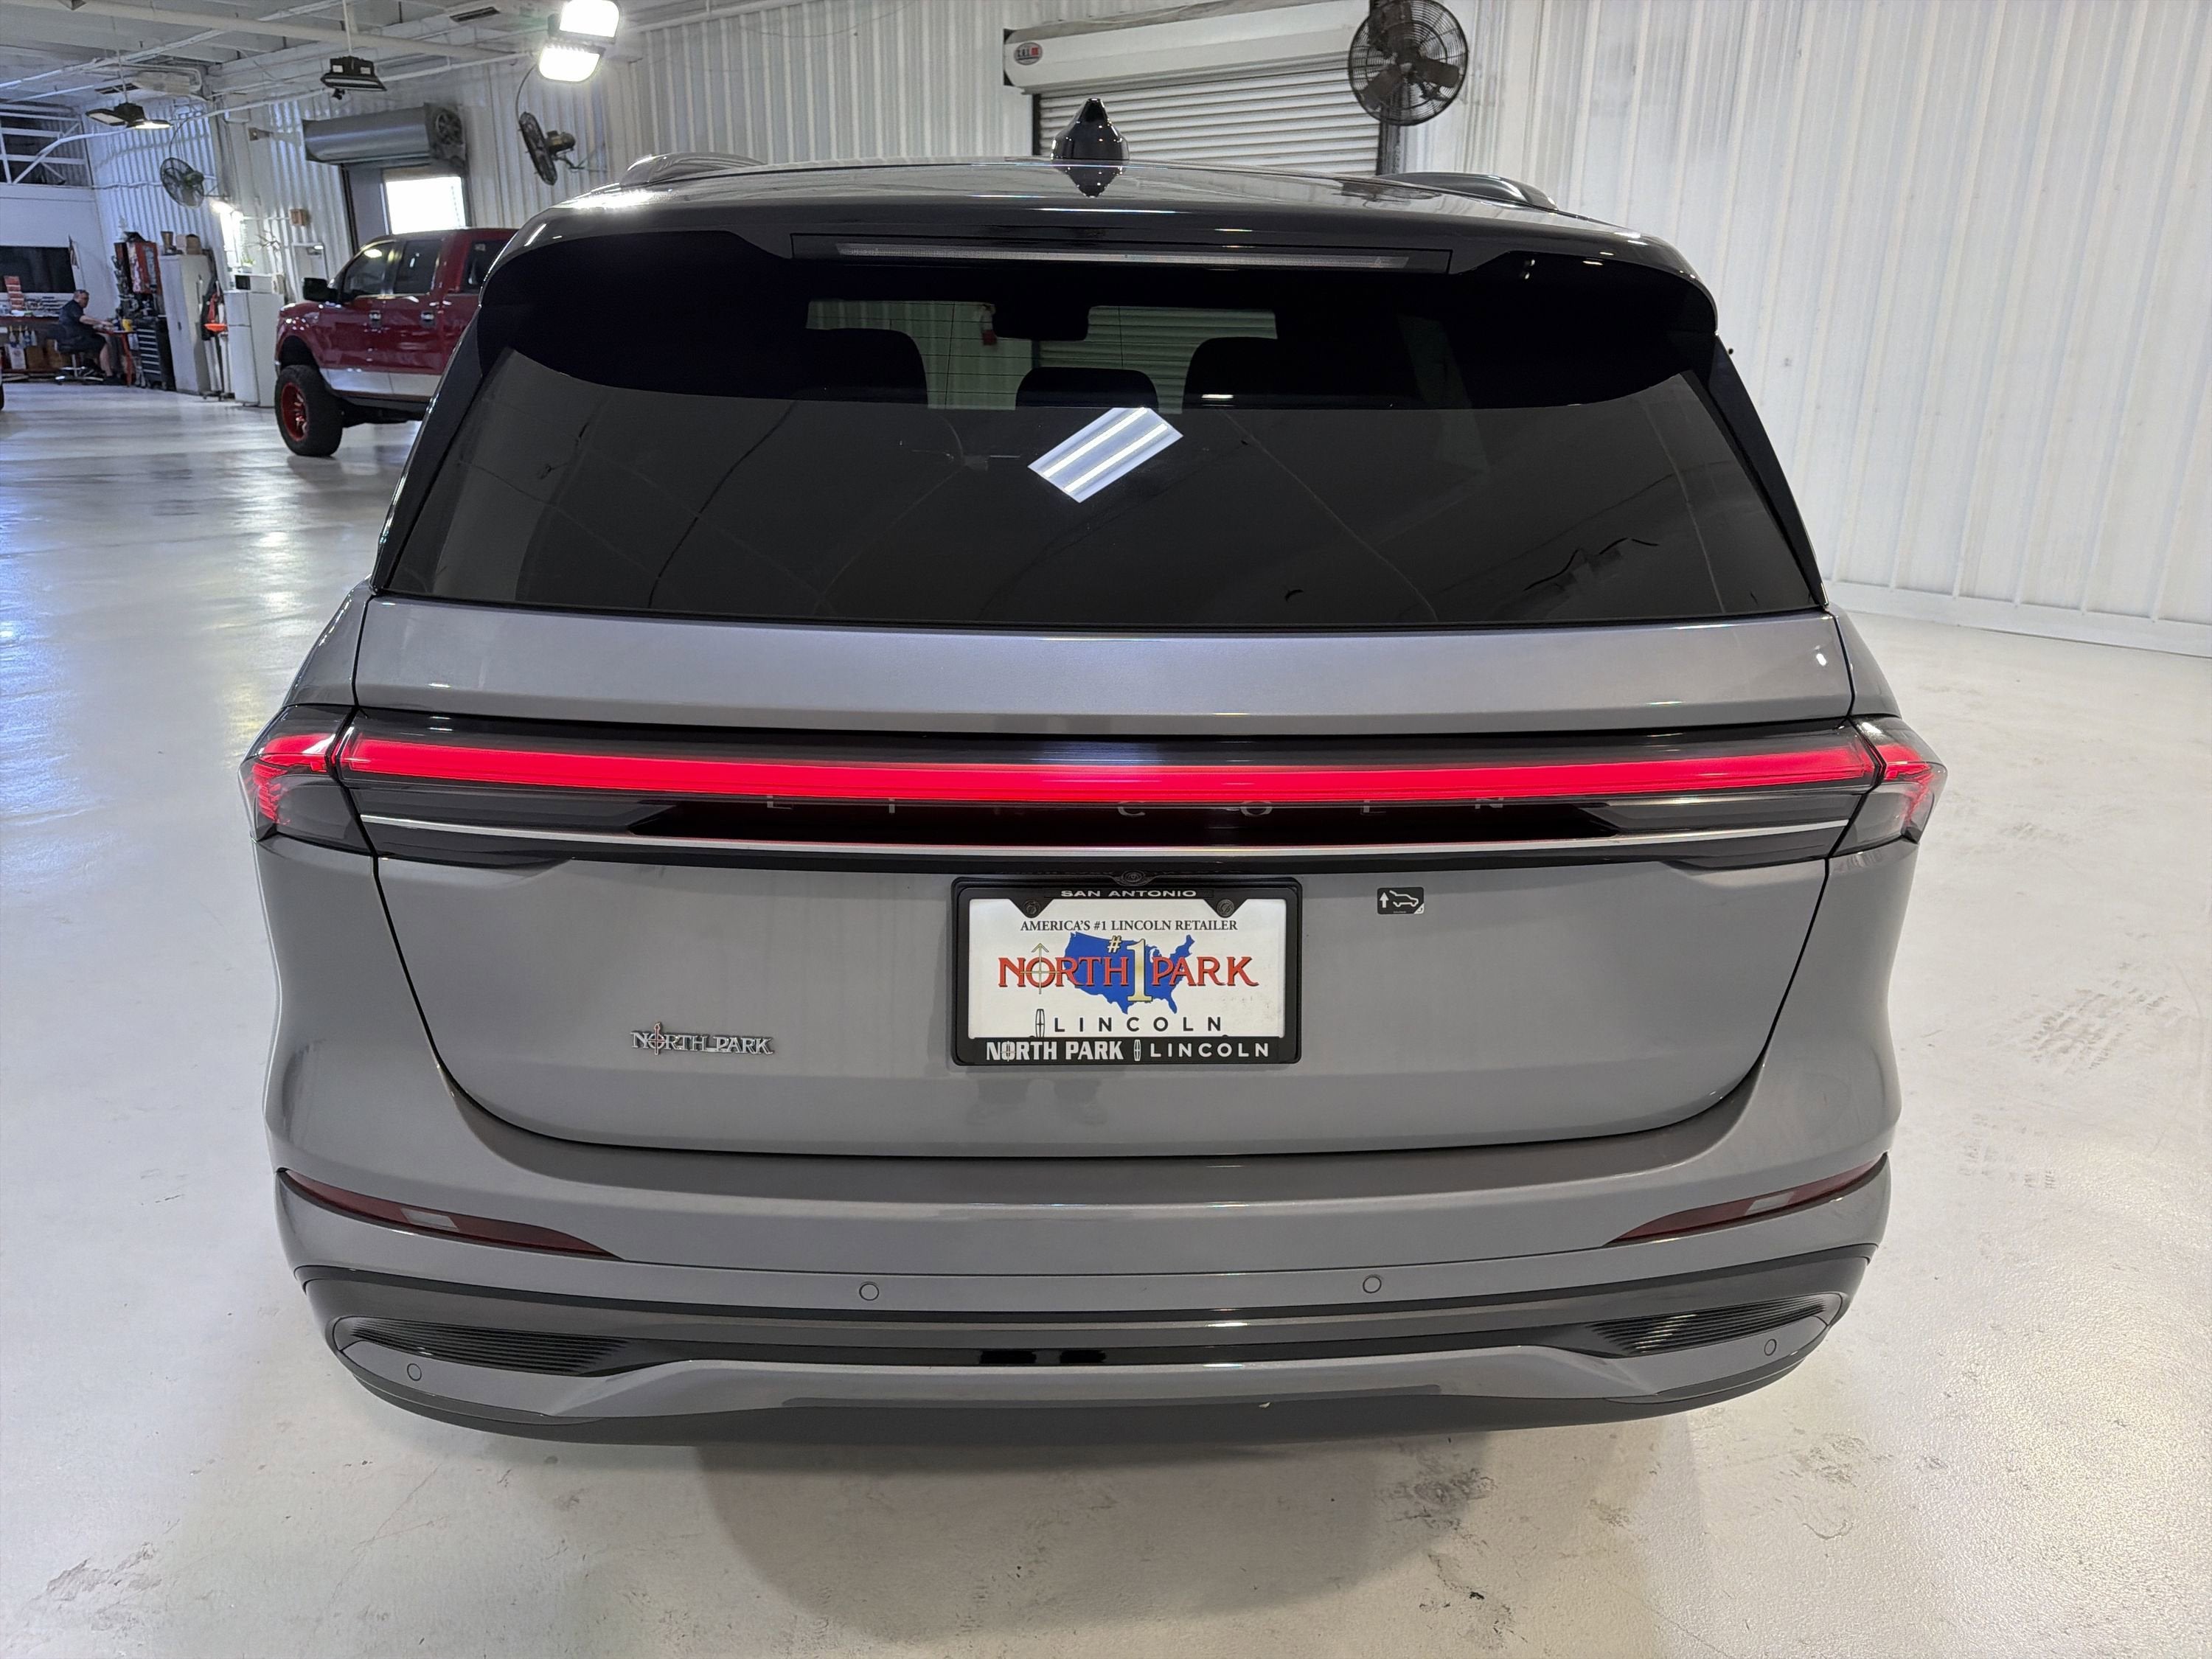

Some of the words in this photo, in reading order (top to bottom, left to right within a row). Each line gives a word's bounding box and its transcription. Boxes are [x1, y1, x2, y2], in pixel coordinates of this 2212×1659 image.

[766, 794, 1505, 817] LICOLN
[1020, 919, 1091, 931] AMERICA'S
[1093, 920, 1107, 931] #1
[1111, 919, 1171, 931] LINCOLN
[1175, 919, 1238, 931] RETAILER
[998, 956, 1130, 988] NORTH
[1152, 956, 1260, 987] PARK
[1054, 1016, 1221, 1033] LINCOLN
[630, 1031, 708, 1052] NORTH
[713, 1035, 773, 1055] PARK
[986, 1040, 1057, 1061] NORTH
[1065, 1040, 1124, 1060] PARK
[1150, 1042, 1269, 1058] LINCOLN
